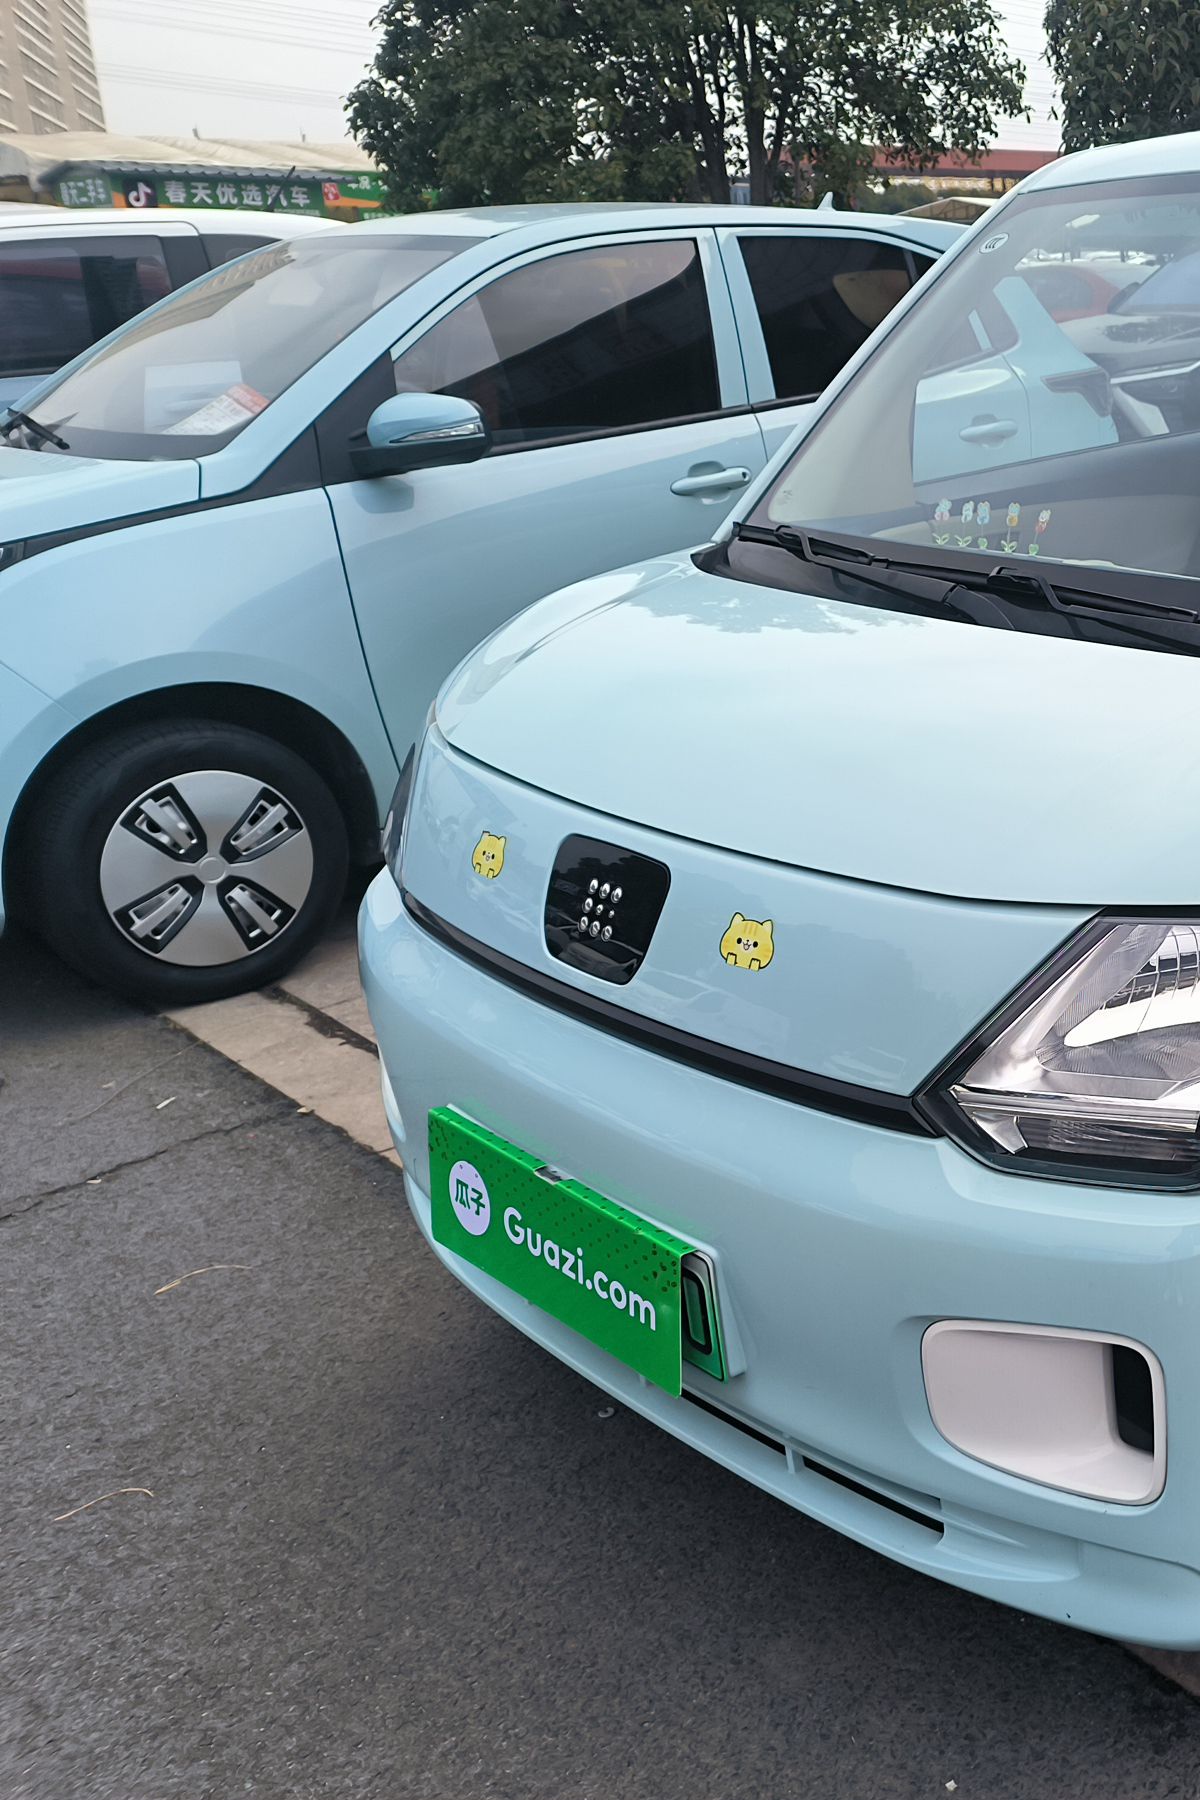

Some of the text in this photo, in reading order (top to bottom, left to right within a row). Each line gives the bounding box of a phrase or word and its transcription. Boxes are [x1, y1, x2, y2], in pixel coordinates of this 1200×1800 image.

[164, 180, 311, 208] 春天优选汽车
[455, 1177, 486, 1216] 瓜子
[503, 1206, 656, 1331] Guazi.com
